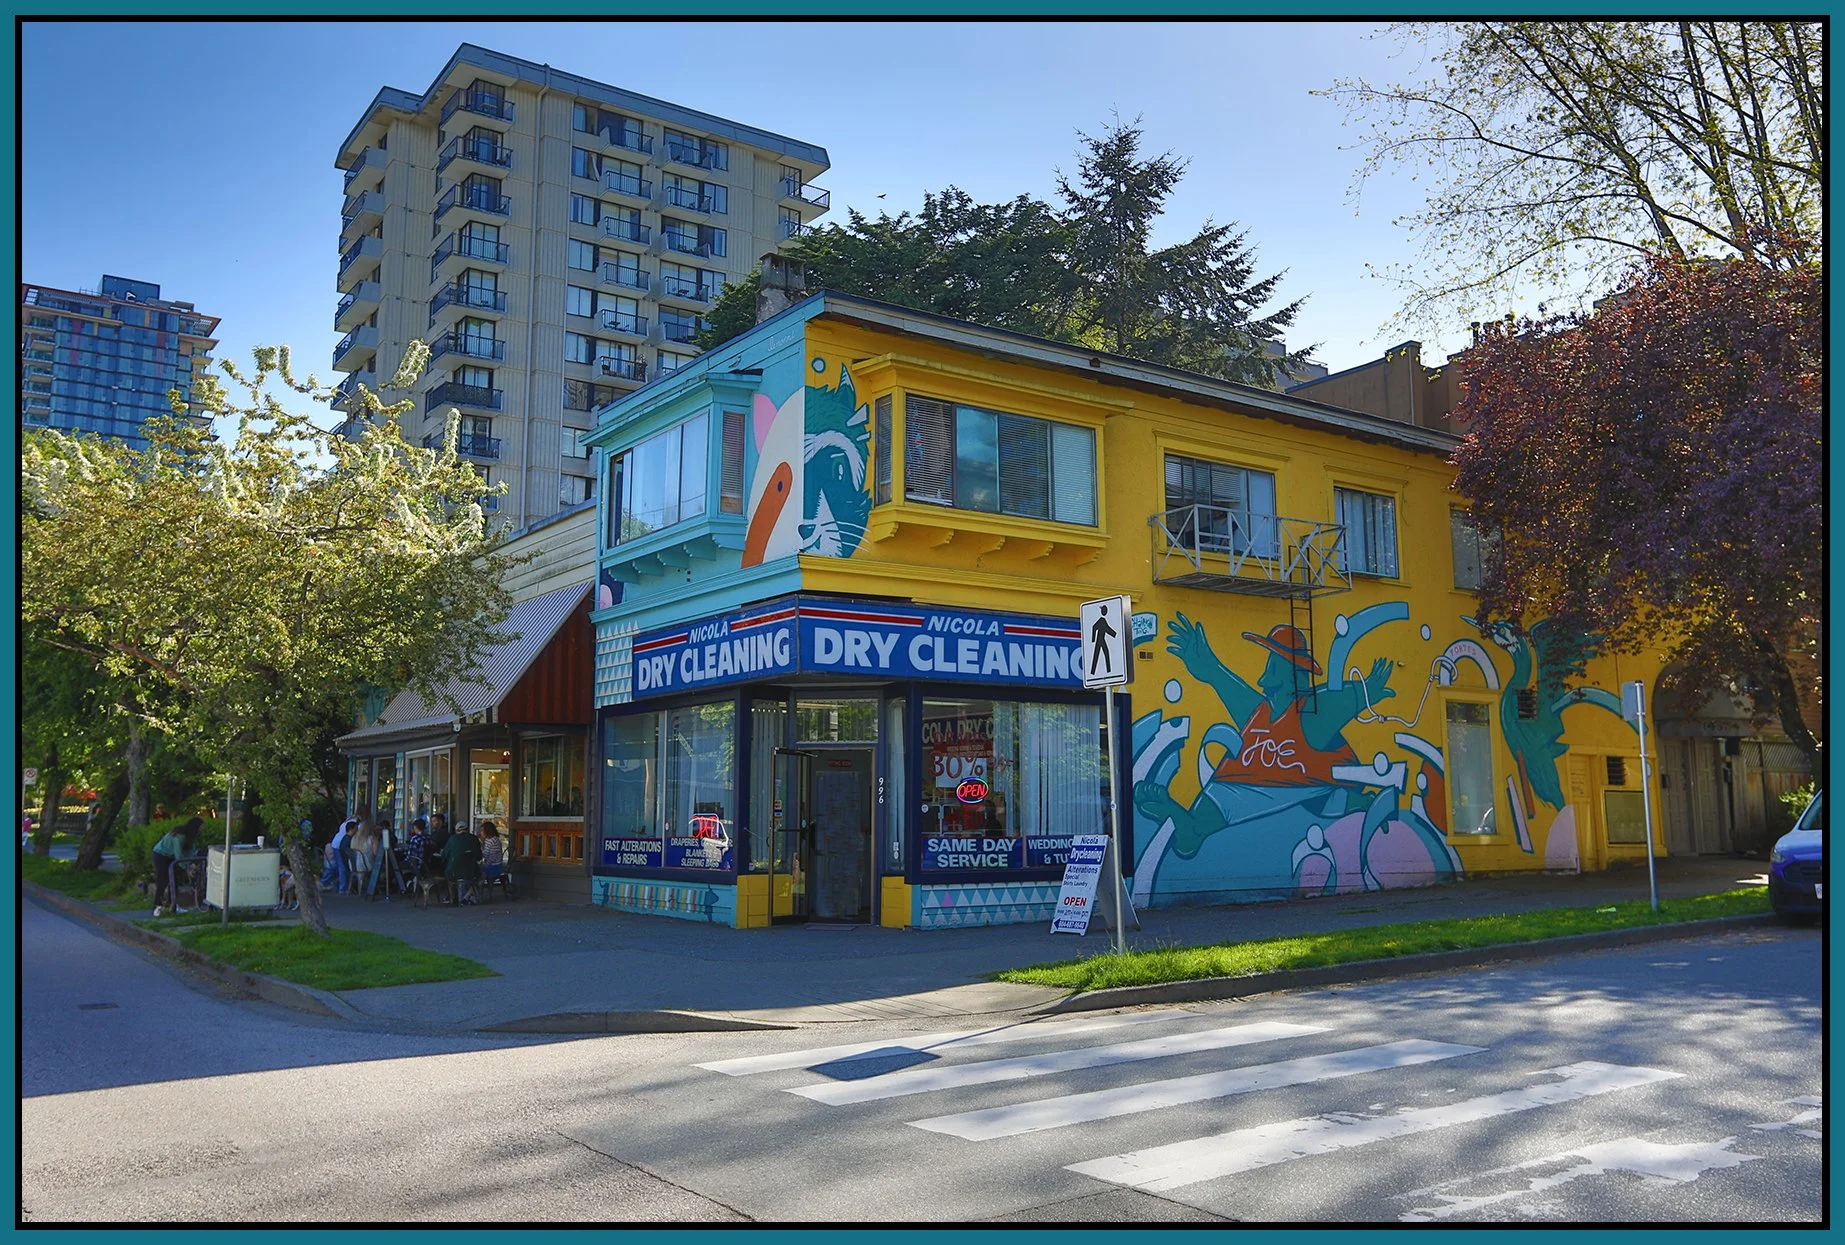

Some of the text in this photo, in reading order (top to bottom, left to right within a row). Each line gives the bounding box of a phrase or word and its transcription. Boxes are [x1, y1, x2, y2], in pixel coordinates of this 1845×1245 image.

[689, 621, 729, 645] NICOLA
[927, 615, 1000, 637] NICOLA
[814, 627, 900, 669] DRY
[638, 627, 790, 691] DRY CLEANING
[922, 720, 954, 744] COLA
[959, 784, 986, 798] OPEN
[604, 840, 662, 853] FAST ALTERATIONS
[928, 838, 1017, 853] SAME DAY
[1080, 836, 1099, 845] Nicola
[622, 853, 648, 866] REPAIRS
[937, 854, 1008, 868] SERVICE
[1044, 853, 1071, 864] & TU
[1070, 847, 1103, 863] Drycleaning
[681, 857, 705, 868] SLEEPING
[1067, 866, 1098, 874] Alterations
[1063, 896, 1087, 907] OPEN
